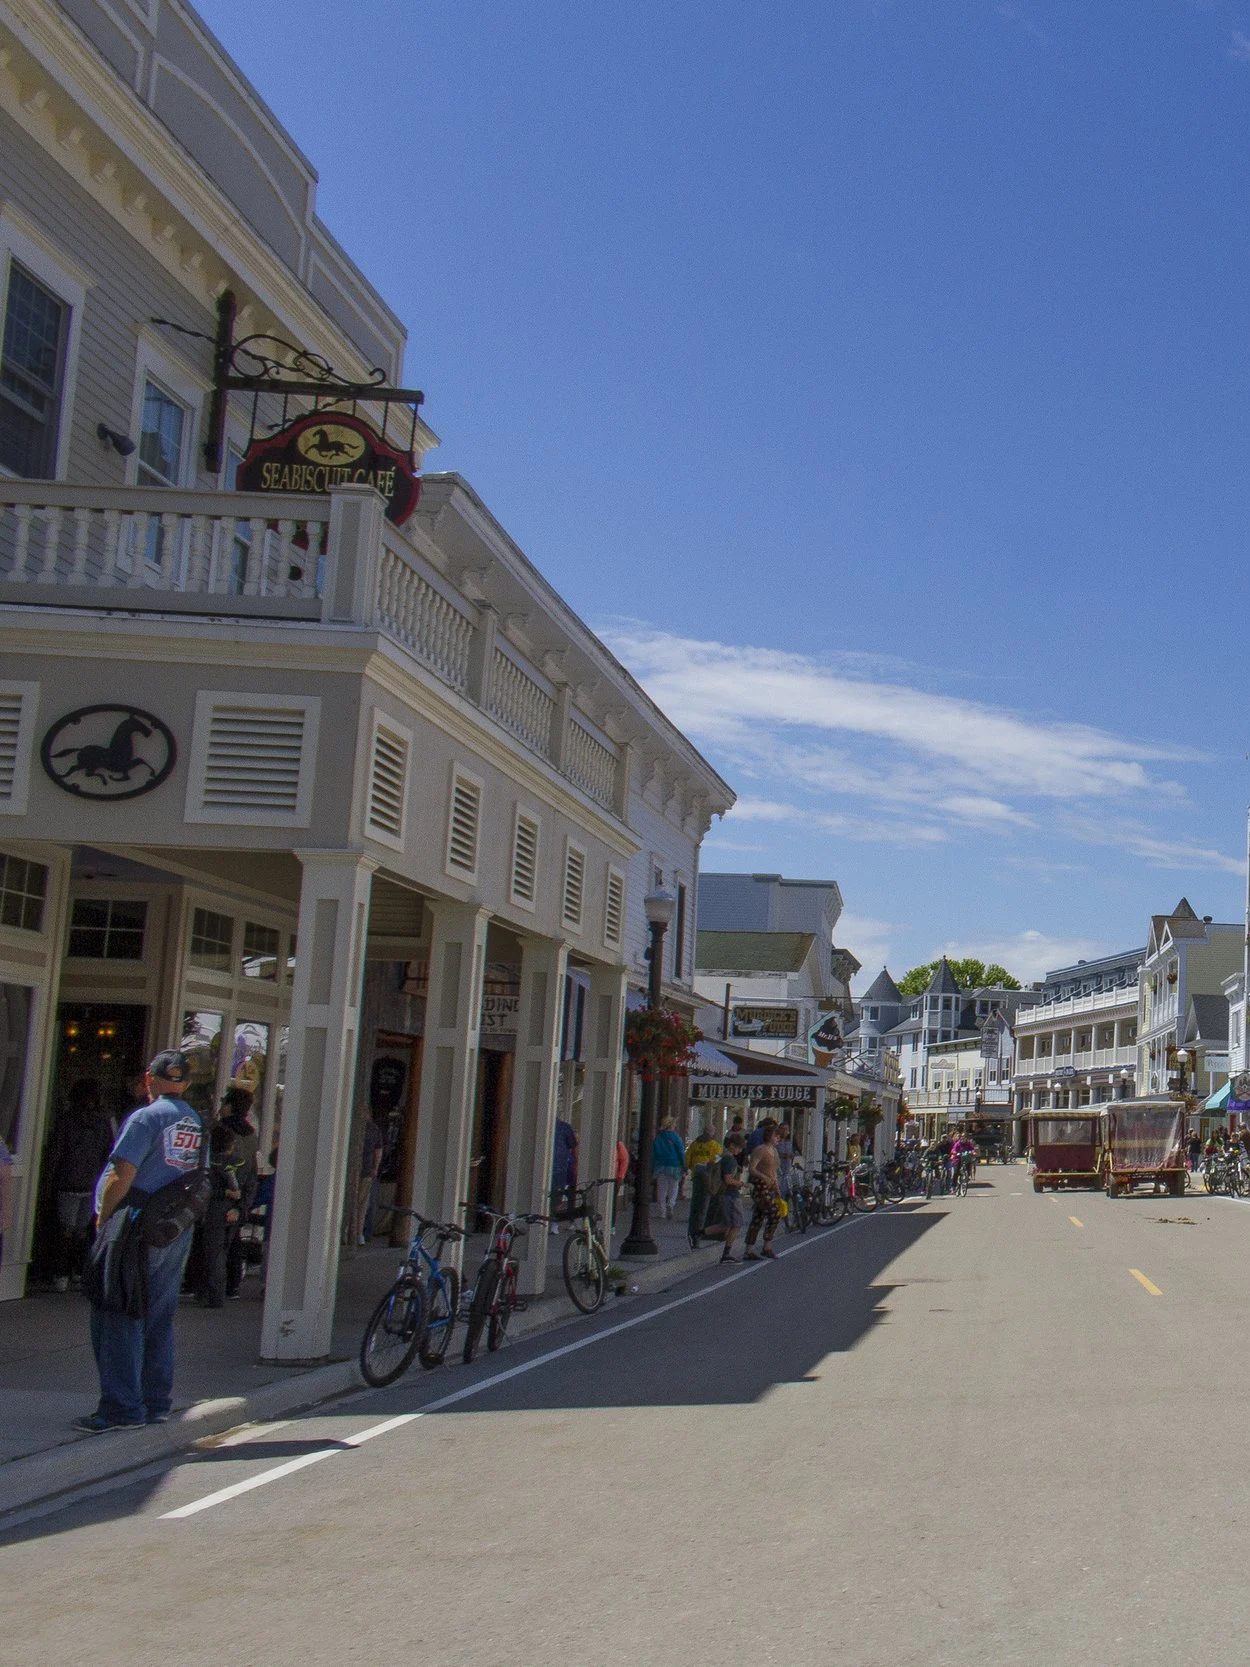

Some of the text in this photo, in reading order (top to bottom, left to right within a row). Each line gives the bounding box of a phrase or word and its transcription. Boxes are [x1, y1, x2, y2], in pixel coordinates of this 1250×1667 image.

[261, 462, 396, 497] SEABISCUIT CAFÉ
[698, 1084, 811, 1100] MURDICKS FUDGE
